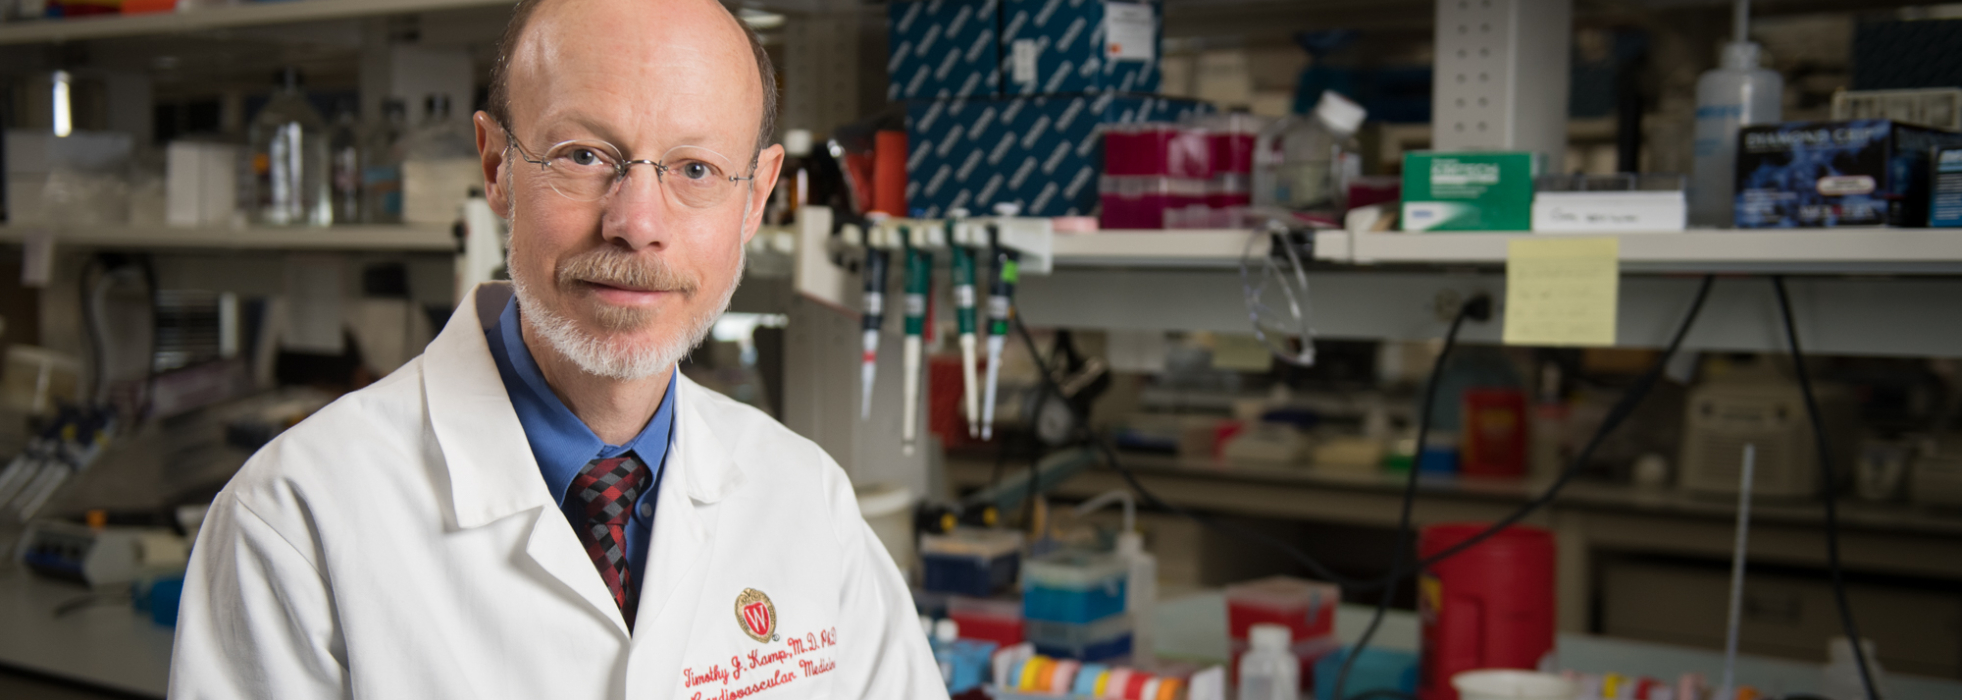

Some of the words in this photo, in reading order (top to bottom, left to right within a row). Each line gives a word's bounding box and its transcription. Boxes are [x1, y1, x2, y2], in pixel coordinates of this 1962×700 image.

[744, 603, 767, 633] W
[683, 664, 730, 688] Timothy
[747, 648, 793, 669] Kamp,
[787, 631, 820, 656] M.D.
